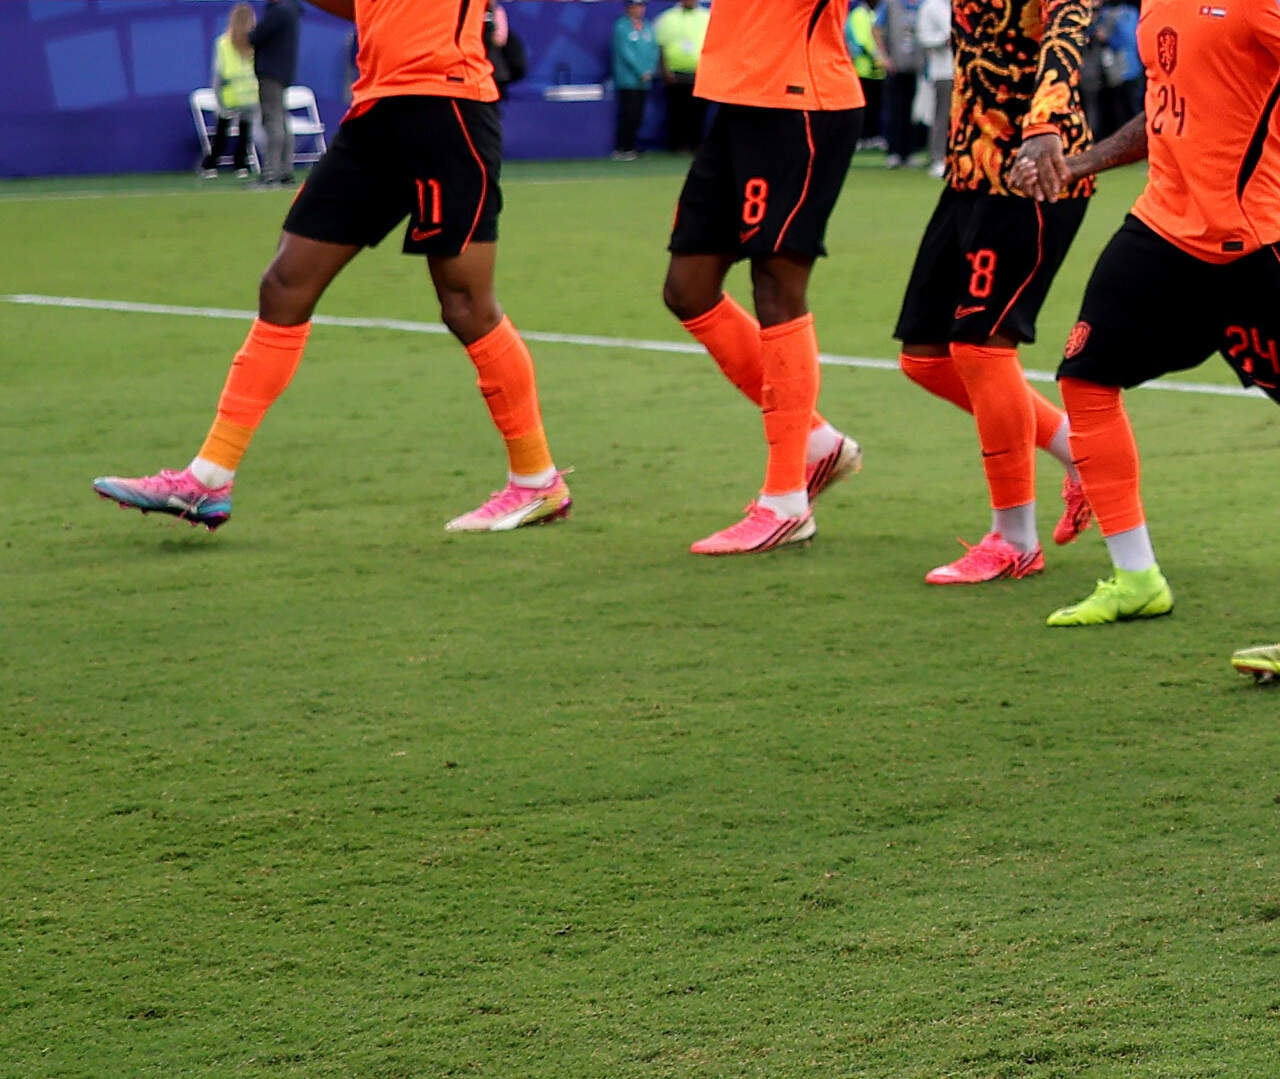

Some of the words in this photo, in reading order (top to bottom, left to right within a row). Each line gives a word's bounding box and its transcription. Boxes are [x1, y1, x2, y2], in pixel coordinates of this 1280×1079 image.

[1152, 83, 1186, 137] 24
[415, 178, 443, 225] 11
[741, 177, 770, 226] 8
[1223, 324, 1280, 375] 24
